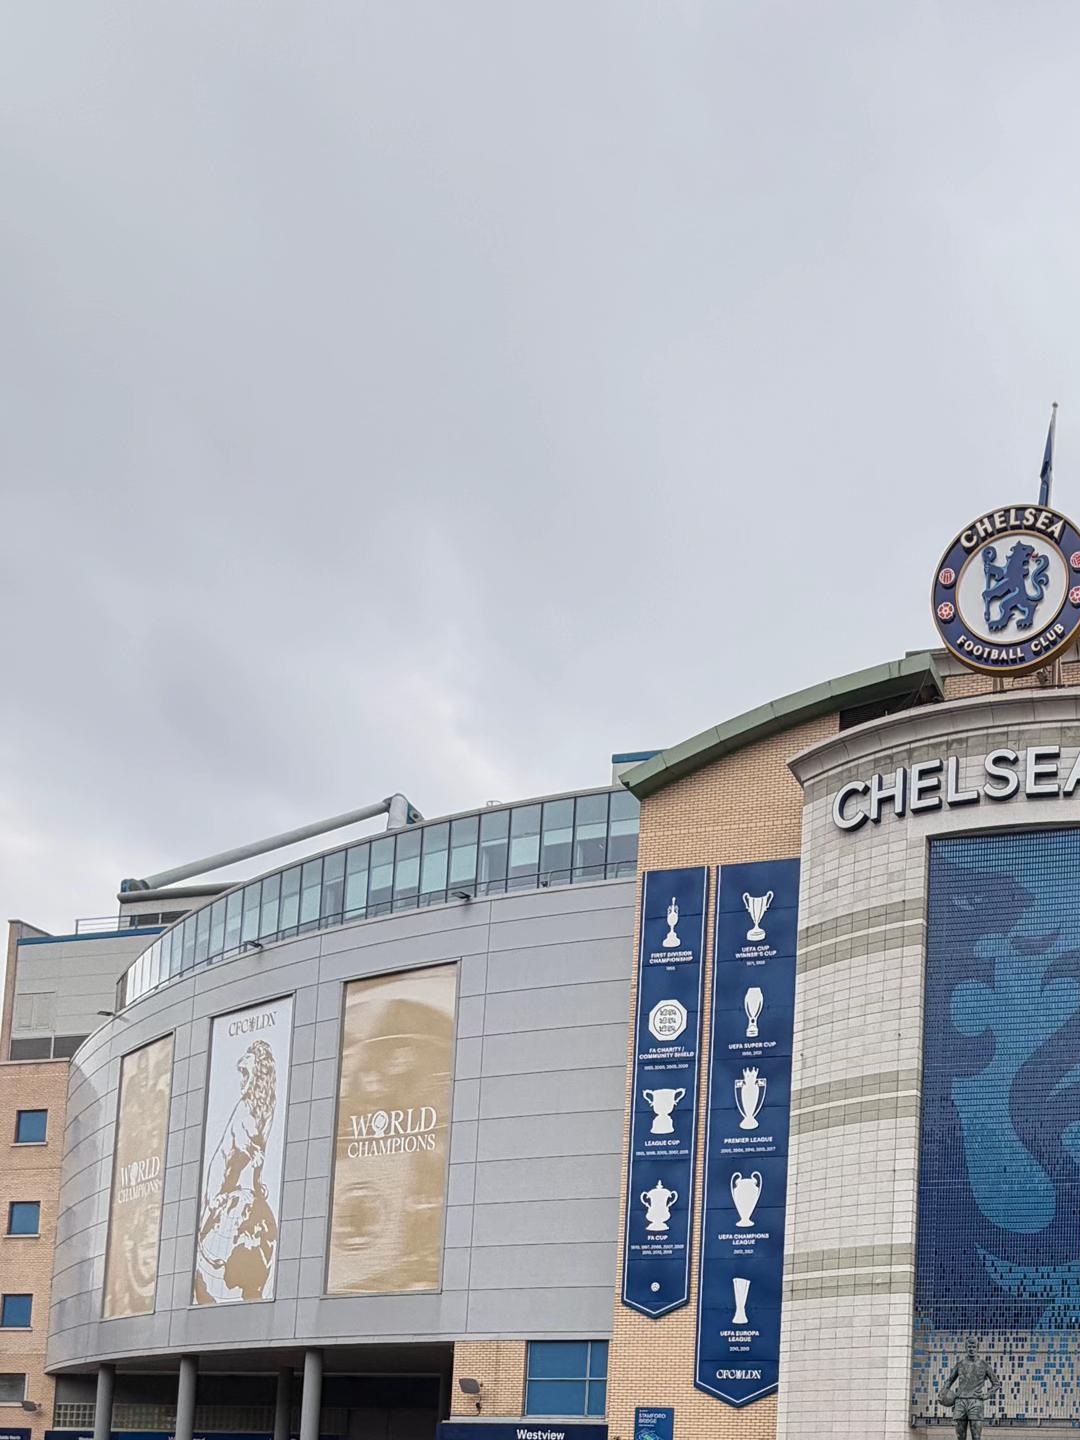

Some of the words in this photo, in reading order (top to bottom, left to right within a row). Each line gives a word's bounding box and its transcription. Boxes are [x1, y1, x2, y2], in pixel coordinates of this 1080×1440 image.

[960, 508, 1065, 548] CHELSEA
[957, 635, 1024, 660] FOOTBALL
[1031, 623, 1064, 651] CLUB
[350, 1106, 436, 1139] WORLD
[348, 1133, 436, 1158] CHAMPIONS
[716, 1369, 736, 1379] CFC
[742, 1369, 762, 1379] LDN
[516, 1429, 565, 1440] Westview
